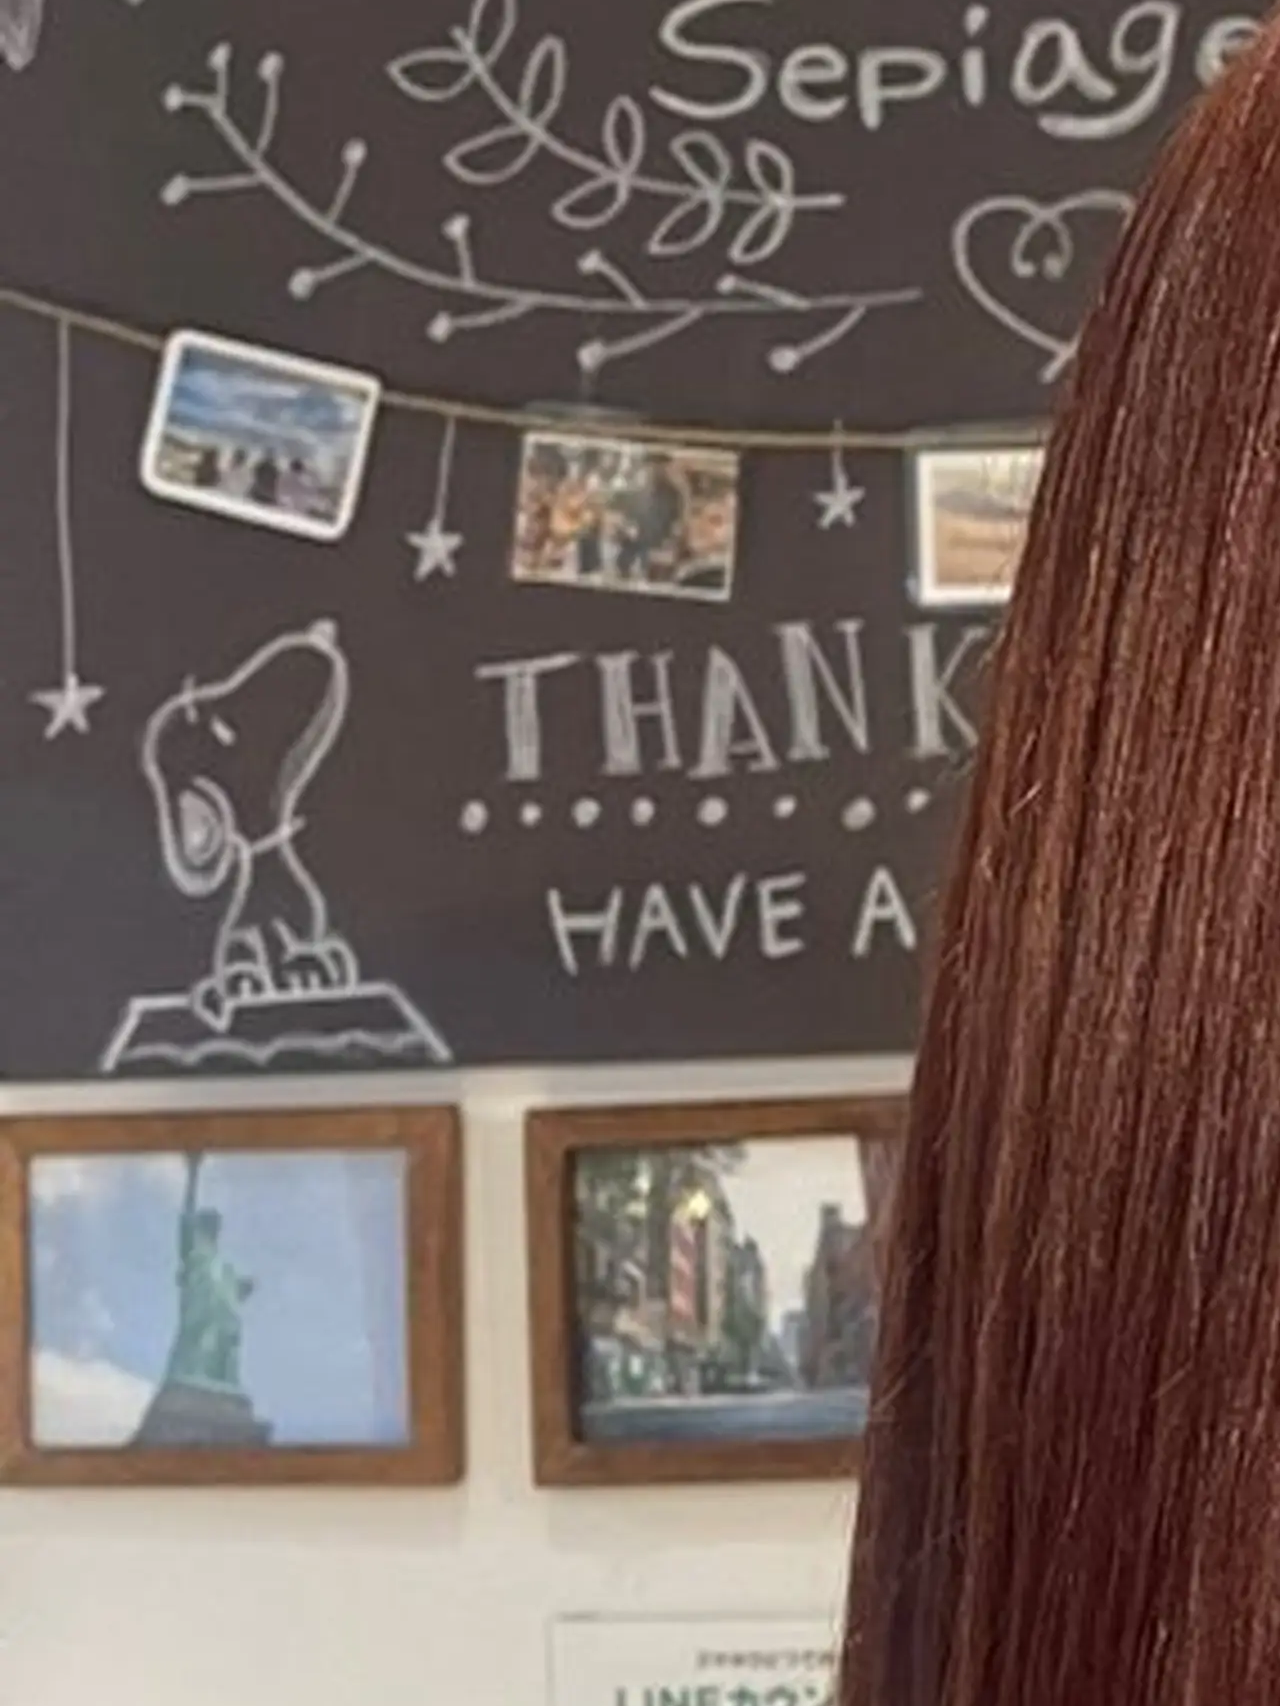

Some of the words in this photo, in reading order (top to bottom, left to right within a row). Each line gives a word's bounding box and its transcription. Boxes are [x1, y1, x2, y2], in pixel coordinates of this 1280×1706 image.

[475, 619, 990, 782] THANK
[548, 872, 808, 975] HAVE
[853, 866, 918, 956] A
